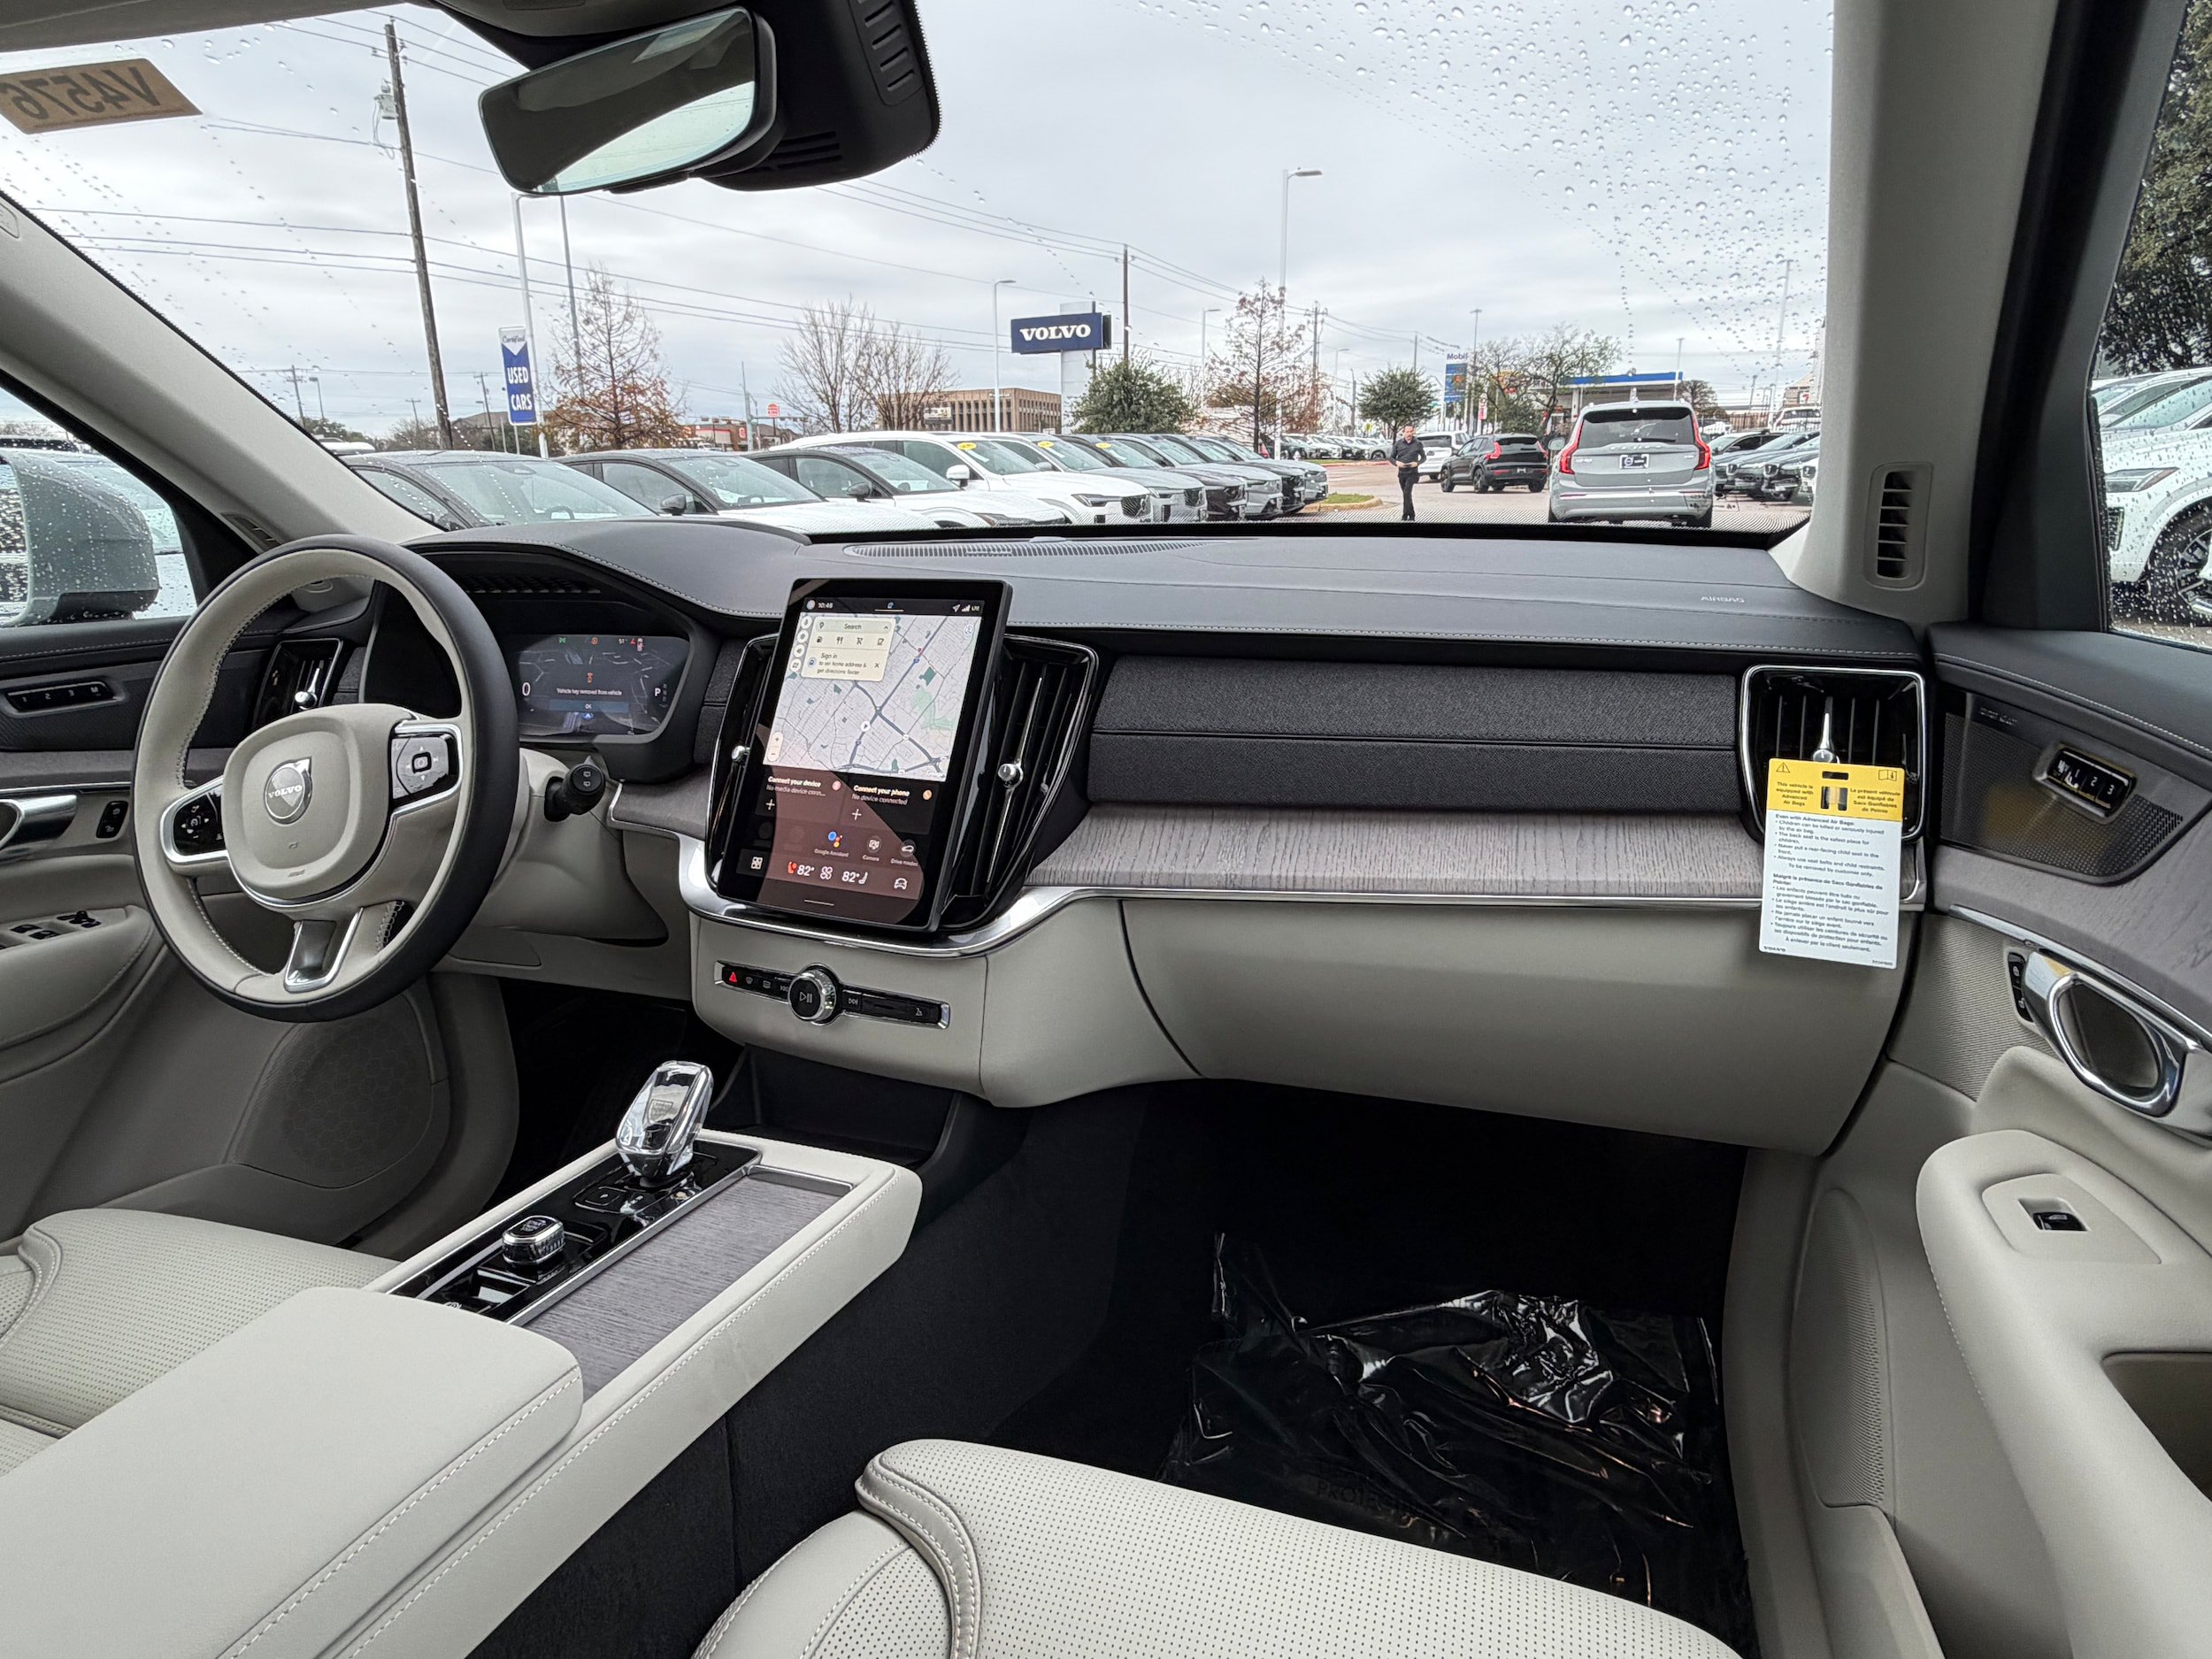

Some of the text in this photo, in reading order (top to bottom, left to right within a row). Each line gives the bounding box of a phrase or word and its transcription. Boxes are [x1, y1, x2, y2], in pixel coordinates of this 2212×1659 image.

[1019, 324, 1092, 342] VOLVO
[507, 366, 529, 384] USED
[511, 394, 533, 411] CARS
[522, 682, 531, 696] 0
[655, 687, 661, 697] P
[767, 776, 790, 785] Connect
[2091, 776, 2098, 787] 2
[2108, 784, 2116, 795] 3
[268, 785, 303, 798] VOLVO
[853, 785, 878, 794] Connect
[797, 864, 815, 877] 82°
[841, 871, 860, 883] 82°
